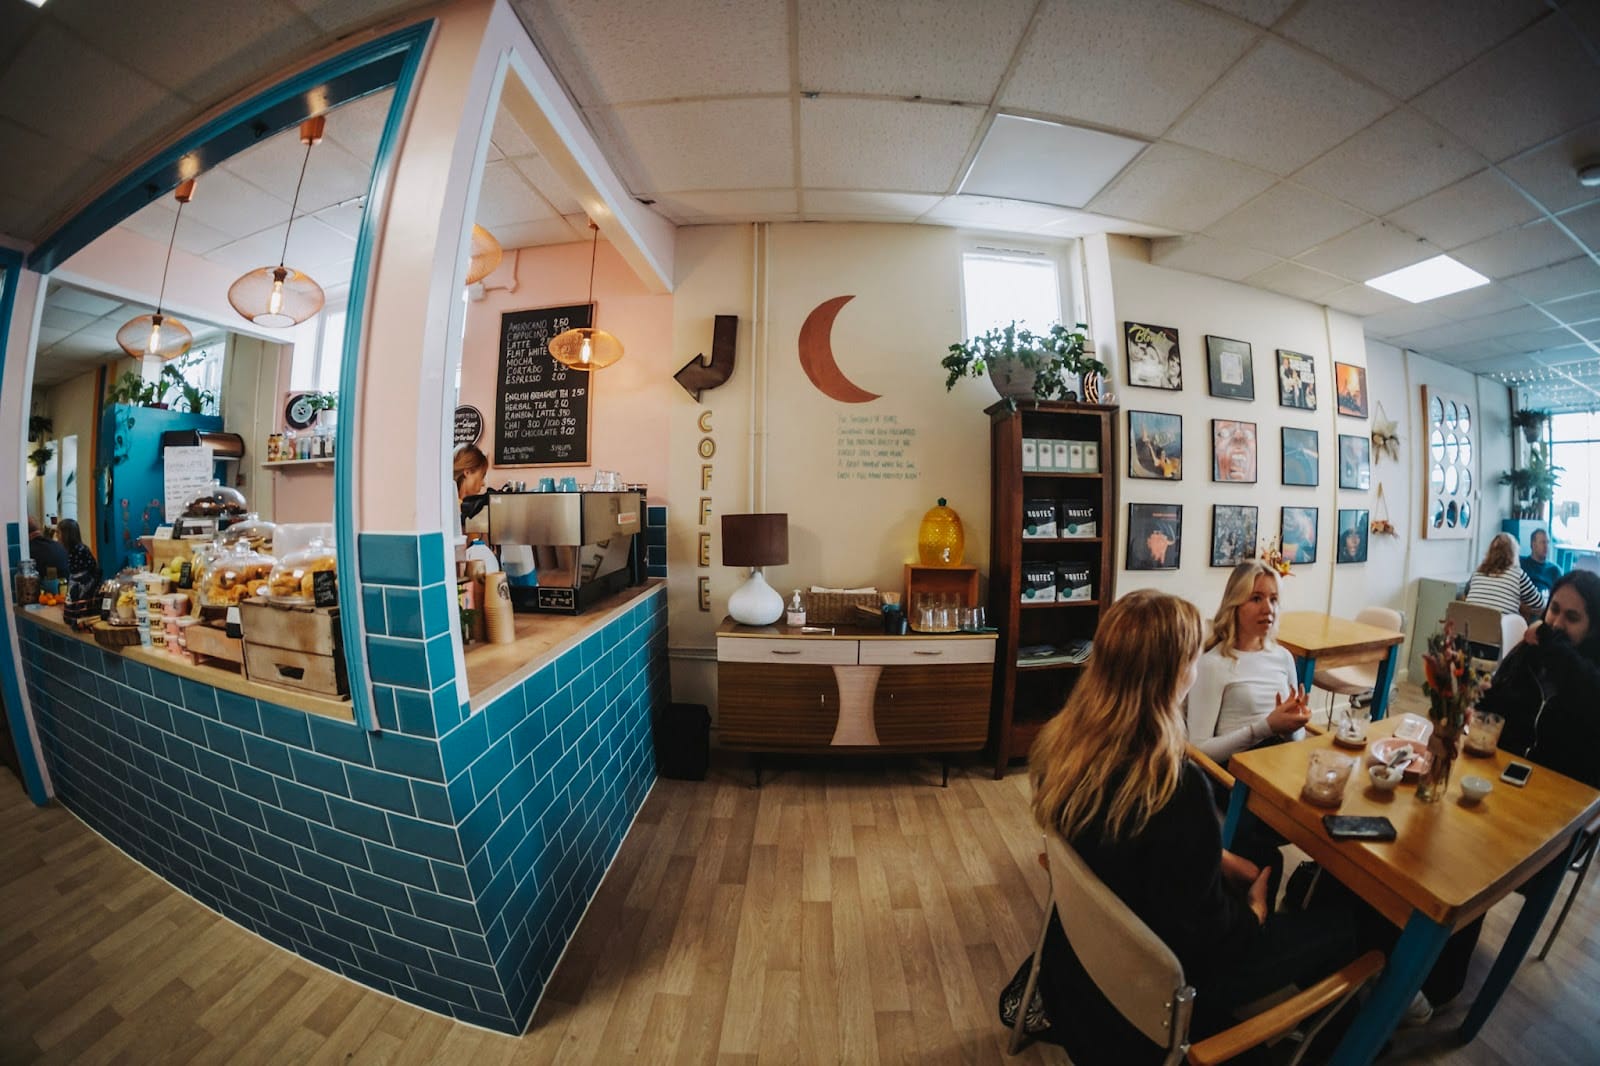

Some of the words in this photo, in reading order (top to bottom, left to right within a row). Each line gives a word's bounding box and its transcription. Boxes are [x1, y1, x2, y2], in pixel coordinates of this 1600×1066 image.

[508, 320, 547, 332] AMERICANO
[507, 340, 530, 349] LATTE
[506, 349, 526, 358] FLAT
[528, 347, 548, 357] WHITE
[506, 357, 533, 367] MOCHA
[507, 366, 543, 376] CORTADO
[505, 375, 541, 385] ESPRESSO
[505, 402, 532, 411] HERBAL
[534, 401, 546, 409] TEA
[536, 409, 555, 418] LATTE
[504, 421, 520, 430] CHAI
[504, 430, 518, 439] HOT
[698, 410, 716, 612] COFFEE
